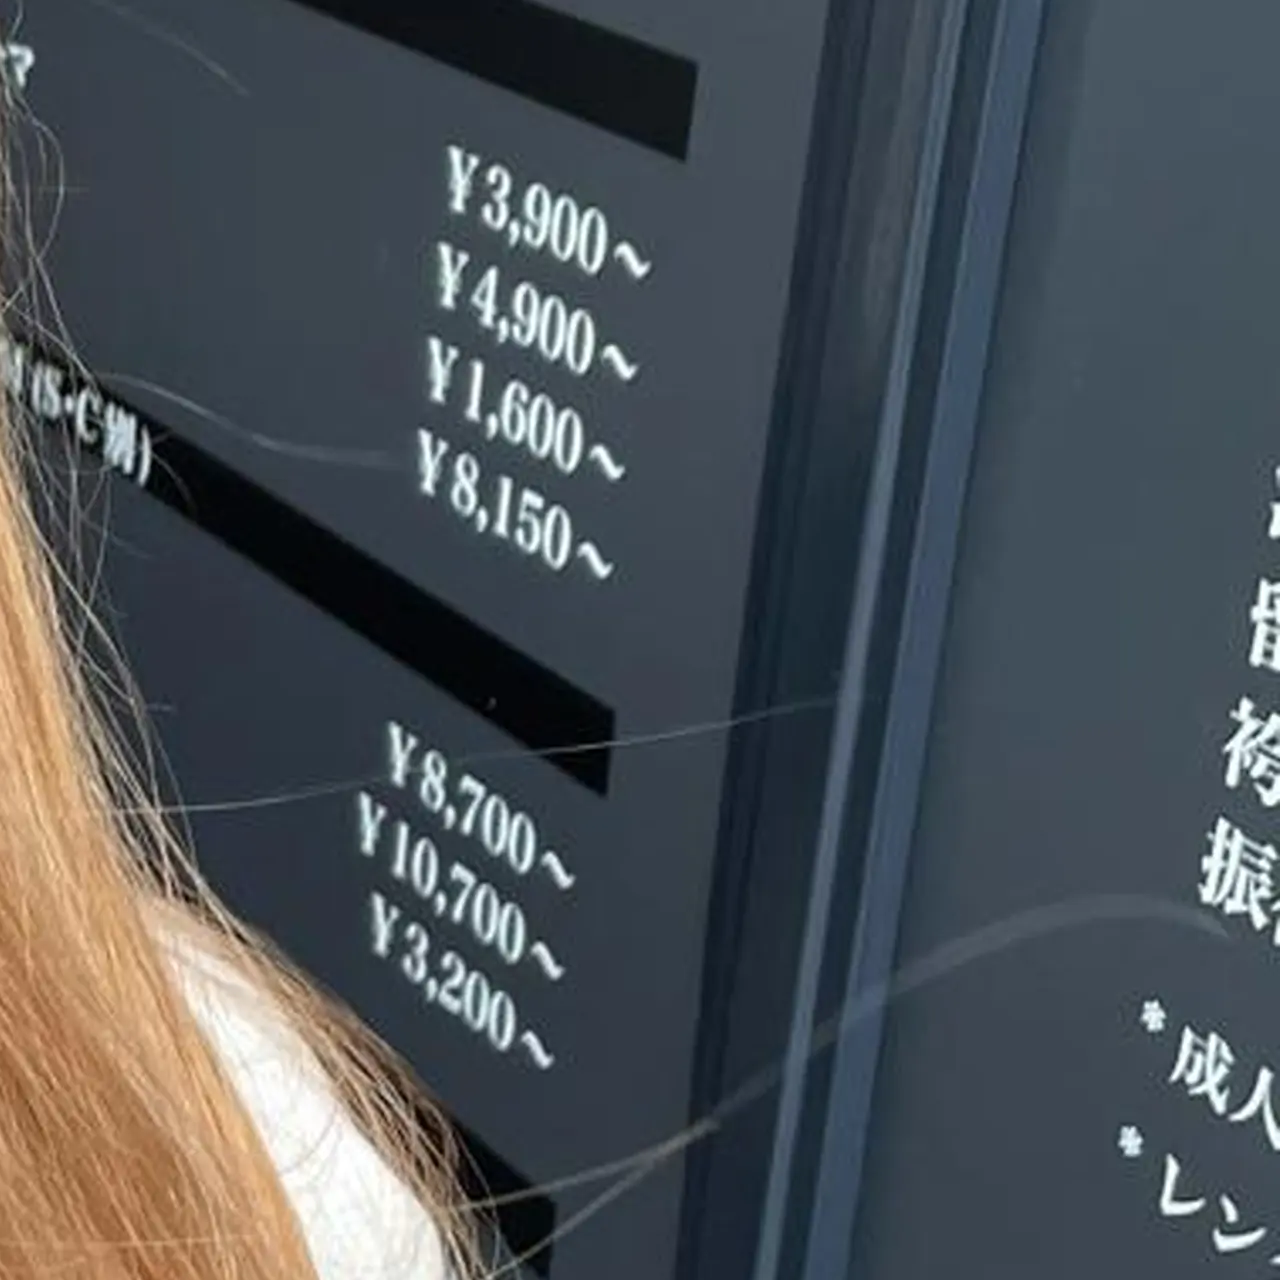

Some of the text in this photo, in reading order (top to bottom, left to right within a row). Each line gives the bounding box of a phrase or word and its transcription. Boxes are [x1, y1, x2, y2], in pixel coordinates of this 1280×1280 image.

[447, 145, 653, 278] ¥3,900~
[438, 241, 639, 381] ¥4,900~
[427, 336, 627, 481] ¥1,600~
[416, 428, 614, 579] ¥8,150~
[387, 721, 576, 890] ¥8,700~
[358, 791, 566, 982] ¥10,700~
[1198, 814, 1280, 946] 振
[370, 891, 555, 1071] ¥3,200~
